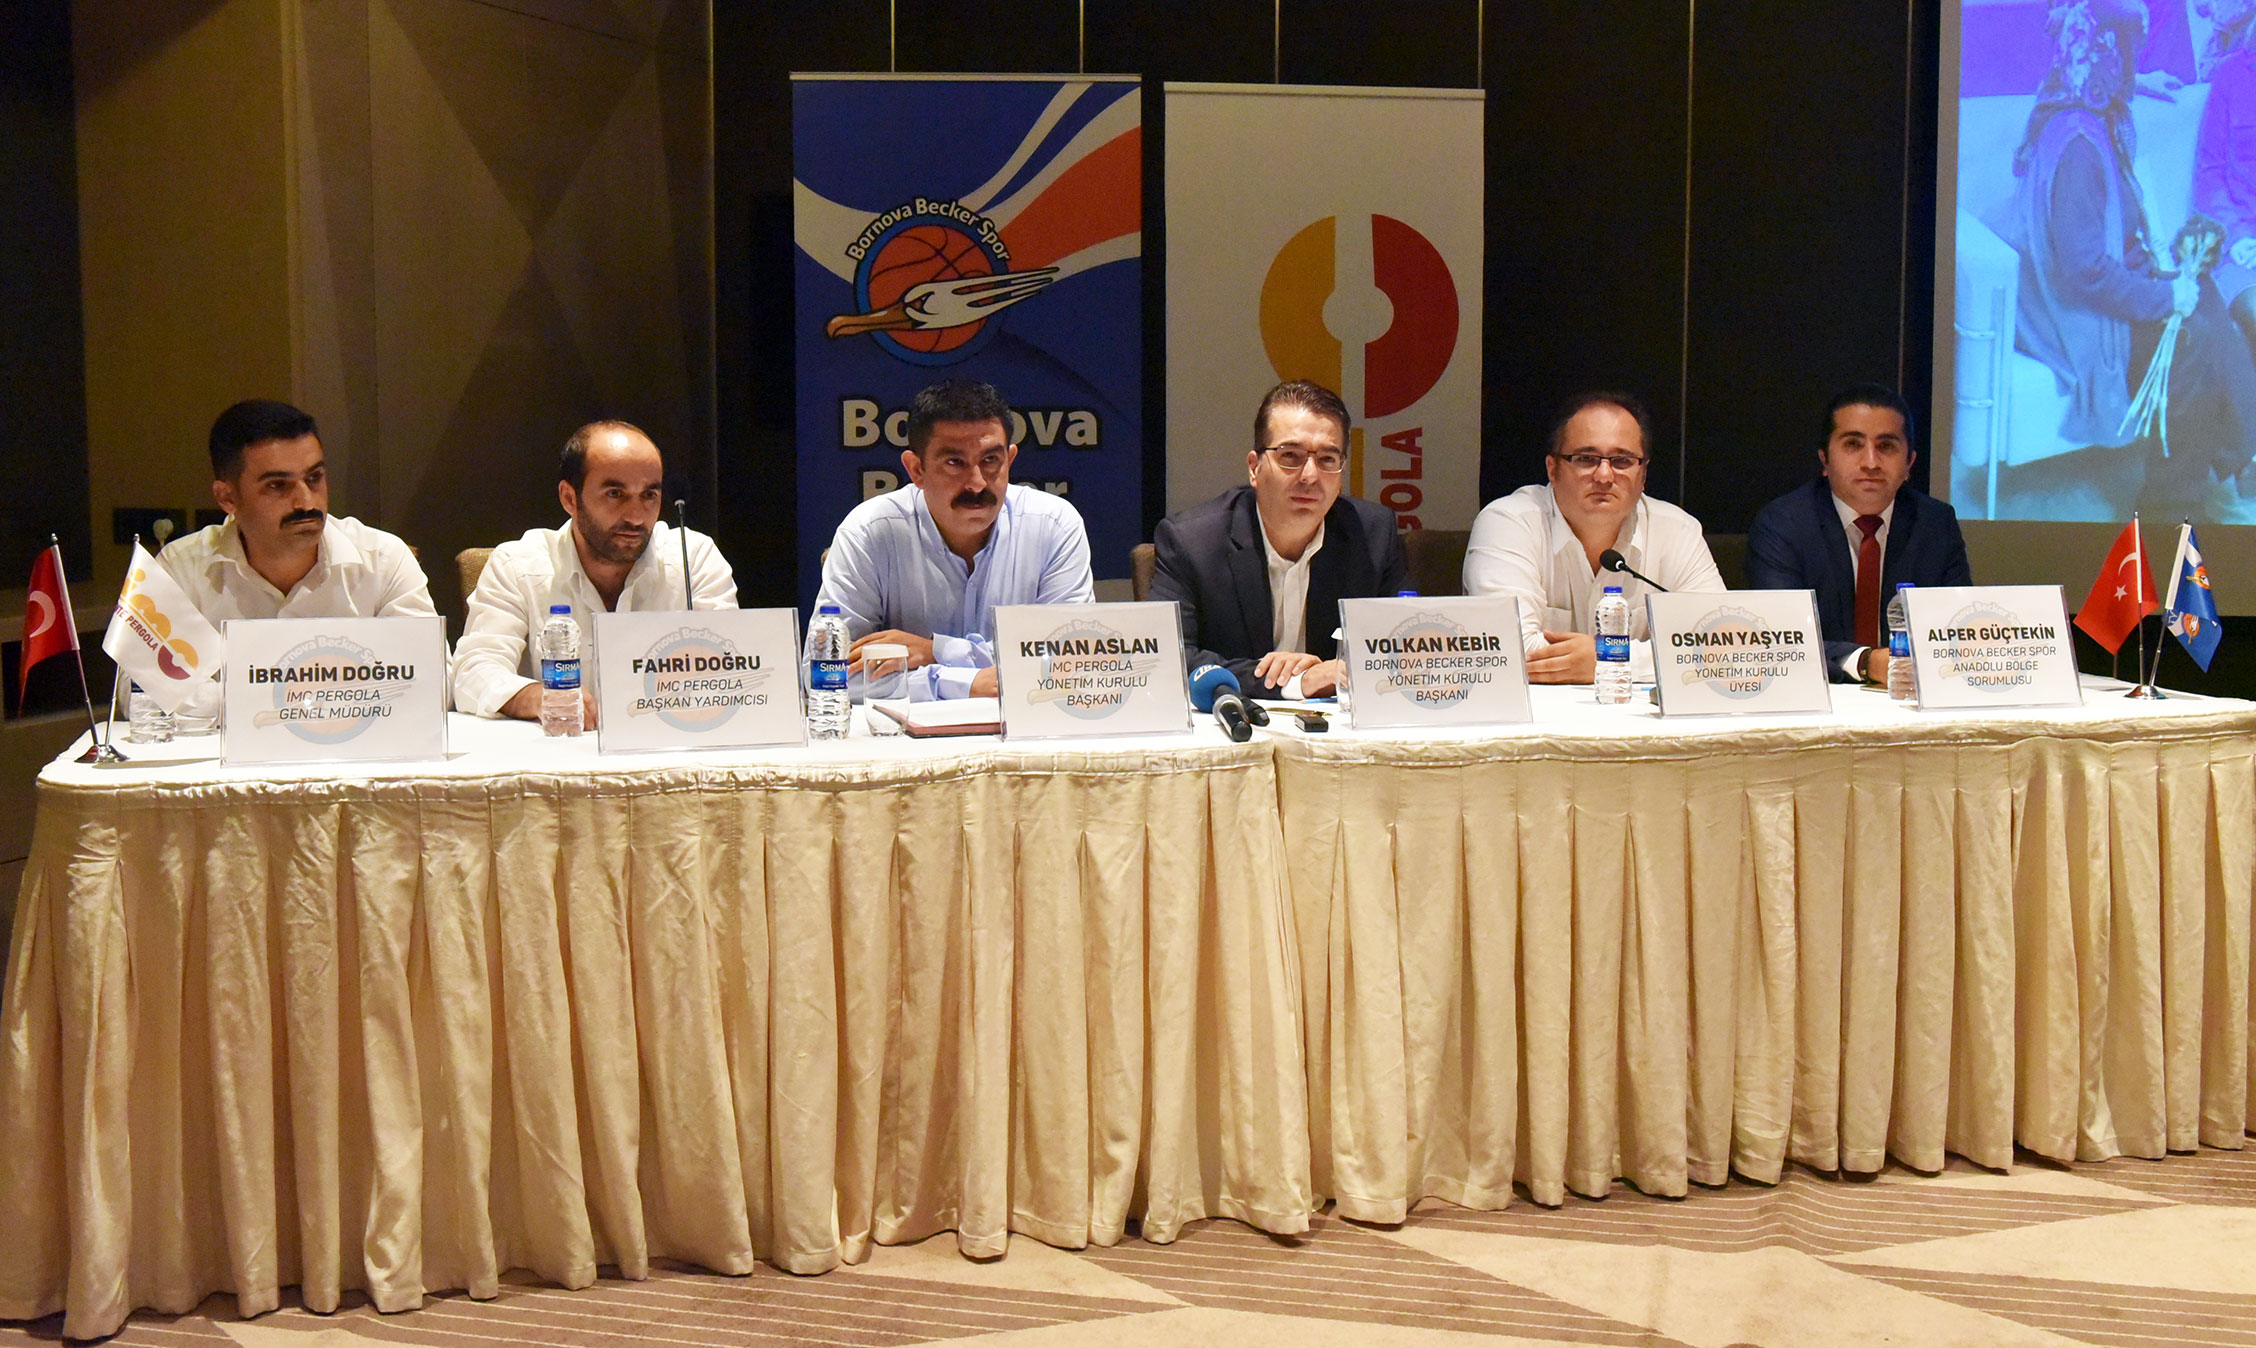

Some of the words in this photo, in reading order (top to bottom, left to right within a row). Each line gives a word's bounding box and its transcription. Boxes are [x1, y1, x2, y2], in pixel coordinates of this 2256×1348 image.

[847, 204, 913, 260] Bornova
[915, 198, 980, 226] Becker
[976, 217, 1011, 261] Spor
[843, 399, 1098, 447] Bova
[125, 615, 159, 651] PERGOLA
[1671, 632, 1734, 647] OSMAN
[1736, 630, 1805, 649] YAŞYER
[1928, 628, 1977, 642] ALPER
[1980, 623, 2056, 644] GÜÇTEKİN
[1020, 640, 1090, 657] KENAN
[1094, 638, 1159, 655] ASLAN
[1365, 637, 1443, 654] VOLKAN
[1446, 632, 1501, 651] KEBİR
[1676, 653, 1730, 664] BORNOVA
[1732, 652, 1774, 663] BECKER
[1776, 651, 1806, 662] SPOR
[1933, 648, 1984, 659] BORNOVA
[1986, 646, 2027, 657] BECKER
[2029, 646, 2057, 656] SPOR
[632, 654, 691, 673] FAHRİ
[695, 652, 761, 671] DOĞRU
[1074, 660, 1133, 672] PERGOLA
[1365, 658, 1423, 671] BORNOVA
[1426, 657, 1473, 669] BECKER
[1475, 656, 1508, 668] SPOR
[1953, 661, 2003, 673] ANADOLU
[249, 663, 338, 684] İBRAHİM
[343, 661, 415, 681] DOĞRU
[1444, 672, 1492, 685] KURULU
[1745, 666, 1789, 677] KURULU
[683, 679, 743, 691] PERGOLA
[1097, 676, 1147, 688] KURULU
[1967, 675, 2033, 687] SORUMLUSU
[316, 689, 381, 702] PERGOLA
[636, 697, 691, 711] BAŞKAN
[694, 694, 768, 707] YARDIMCISI
[1067, 693, 1122, 708] BAŞKANI
[1416, 689, 1469, 704] BAŞKANI
[279, 707, 325, 720] GENEL
[329, 703, 392, 719] MÜDÜRÜ
